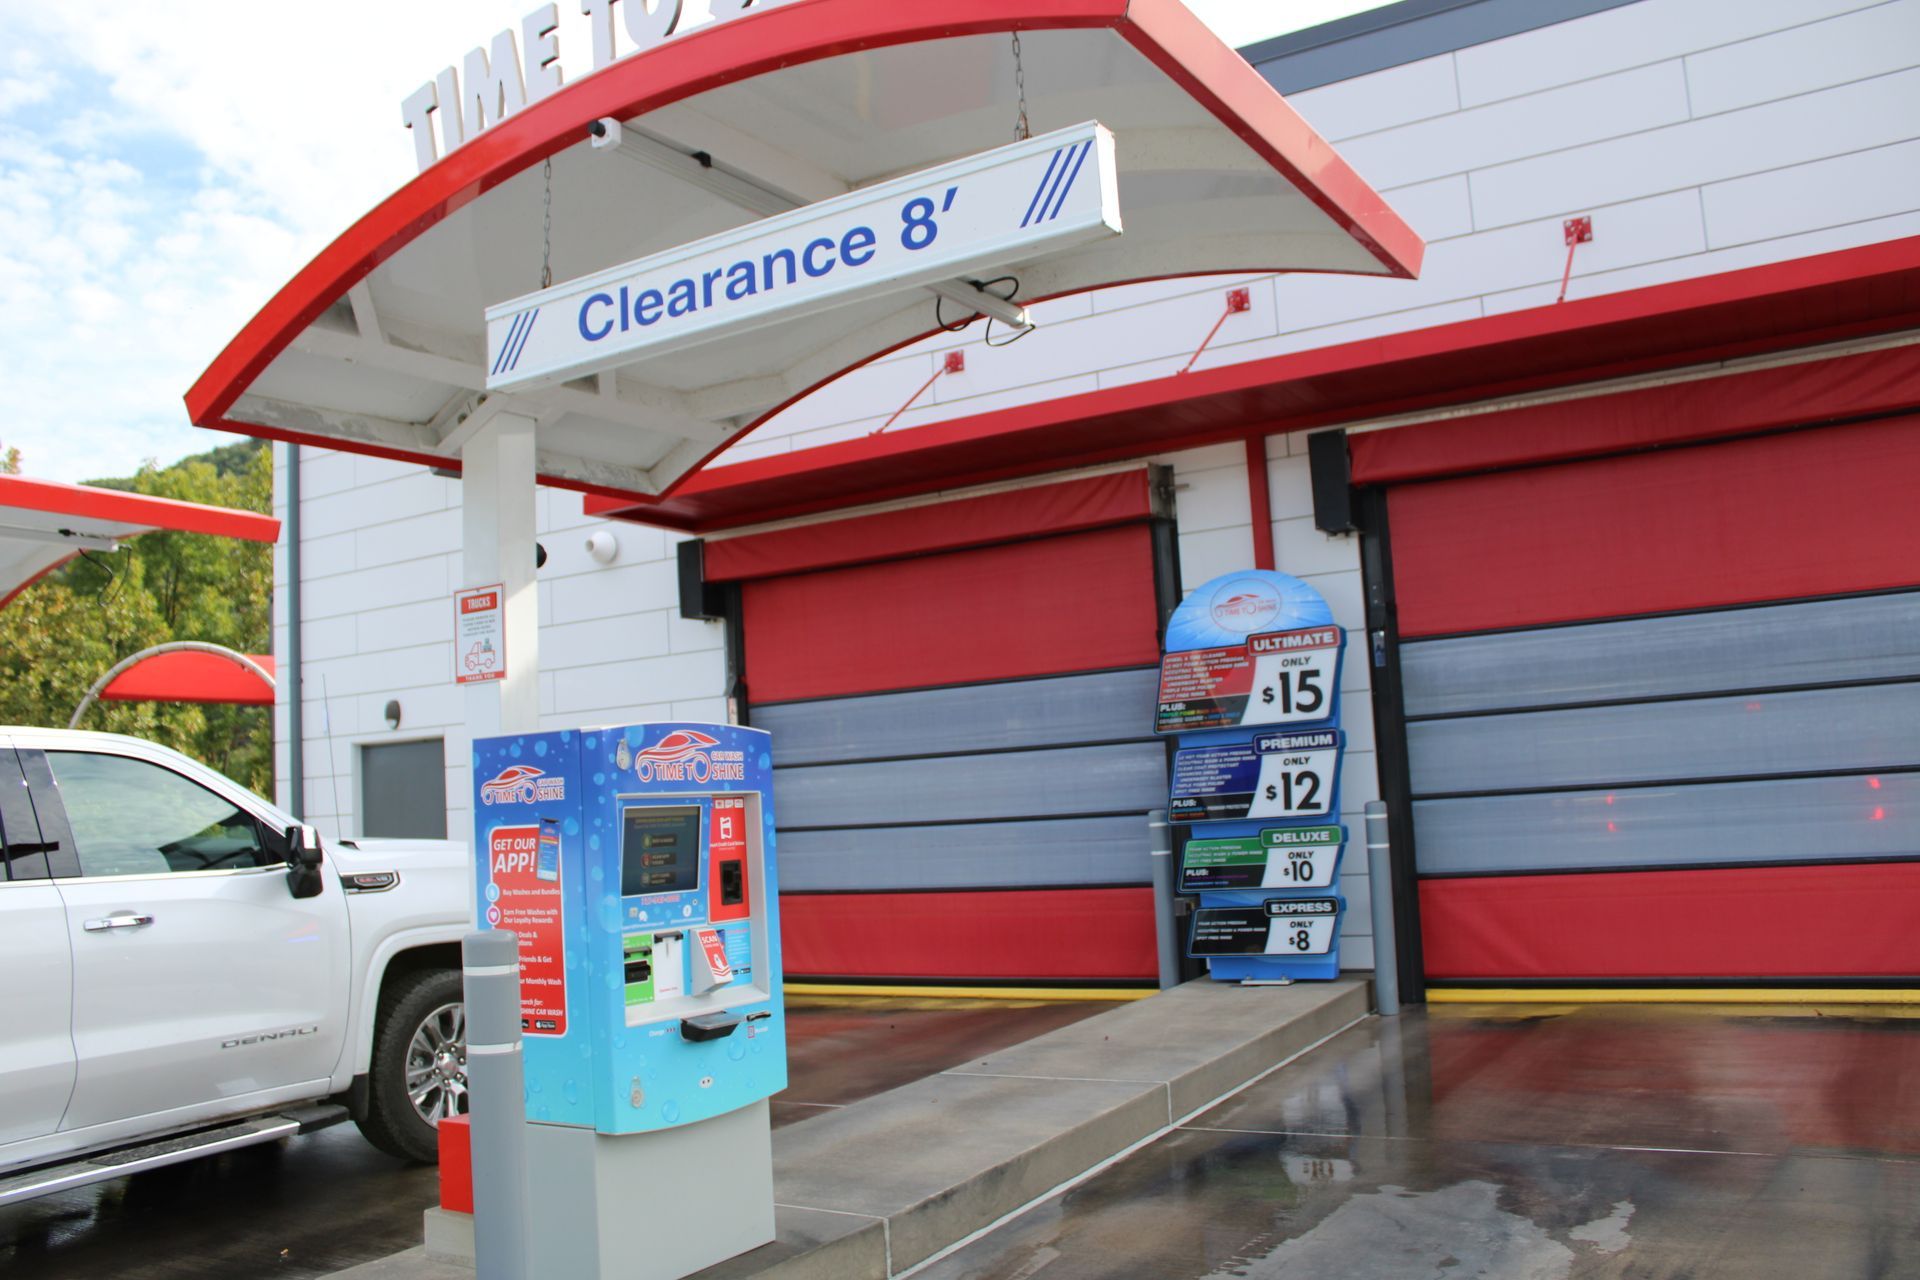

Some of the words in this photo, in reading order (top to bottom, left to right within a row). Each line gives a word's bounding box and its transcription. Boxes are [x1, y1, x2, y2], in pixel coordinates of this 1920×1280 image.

[401, 2, 563, 172] TIME
[578, 226, 876, 342] Clearance
[900, 186, 959, 251] 8'
[1253, 631, 1334, 651] ULTIMATE
[1282, 656, 1311, 667] ONLY
[1262, 669, 1323, 714] $15
[1160, 703, 1186, 712] PLUS:
[1260, 734, 1333, 750] PREMIUM
[1283, 757, 1310, 766] ONLY
[655, 762, 685, 781] TIME
[712, 762, 744, 780] SHINE
[495, 790, 517, 803] TIME
[537, 786, 564, 801] SHINE
[1266, 770, 1322, 811] $12
[1173, 799, 1197, 807] PLUS:
[493, 839, 512, 852] GET
[514, 837, 536, 851] OUR
[1272, 831, 1330, 843] DELUXE
[494, 852, 536, 873] APP!
[1288, 851, 1314, 859] ONLY
[1186, 868, 1209, 876] PLUS:
[1283, 861, 1313, 882] $10
[1271, 902, 1332, 913] EXPRESS
[1289, 930, 1310, 951] $8
[222, 1026, 317, 1048] DENALI
